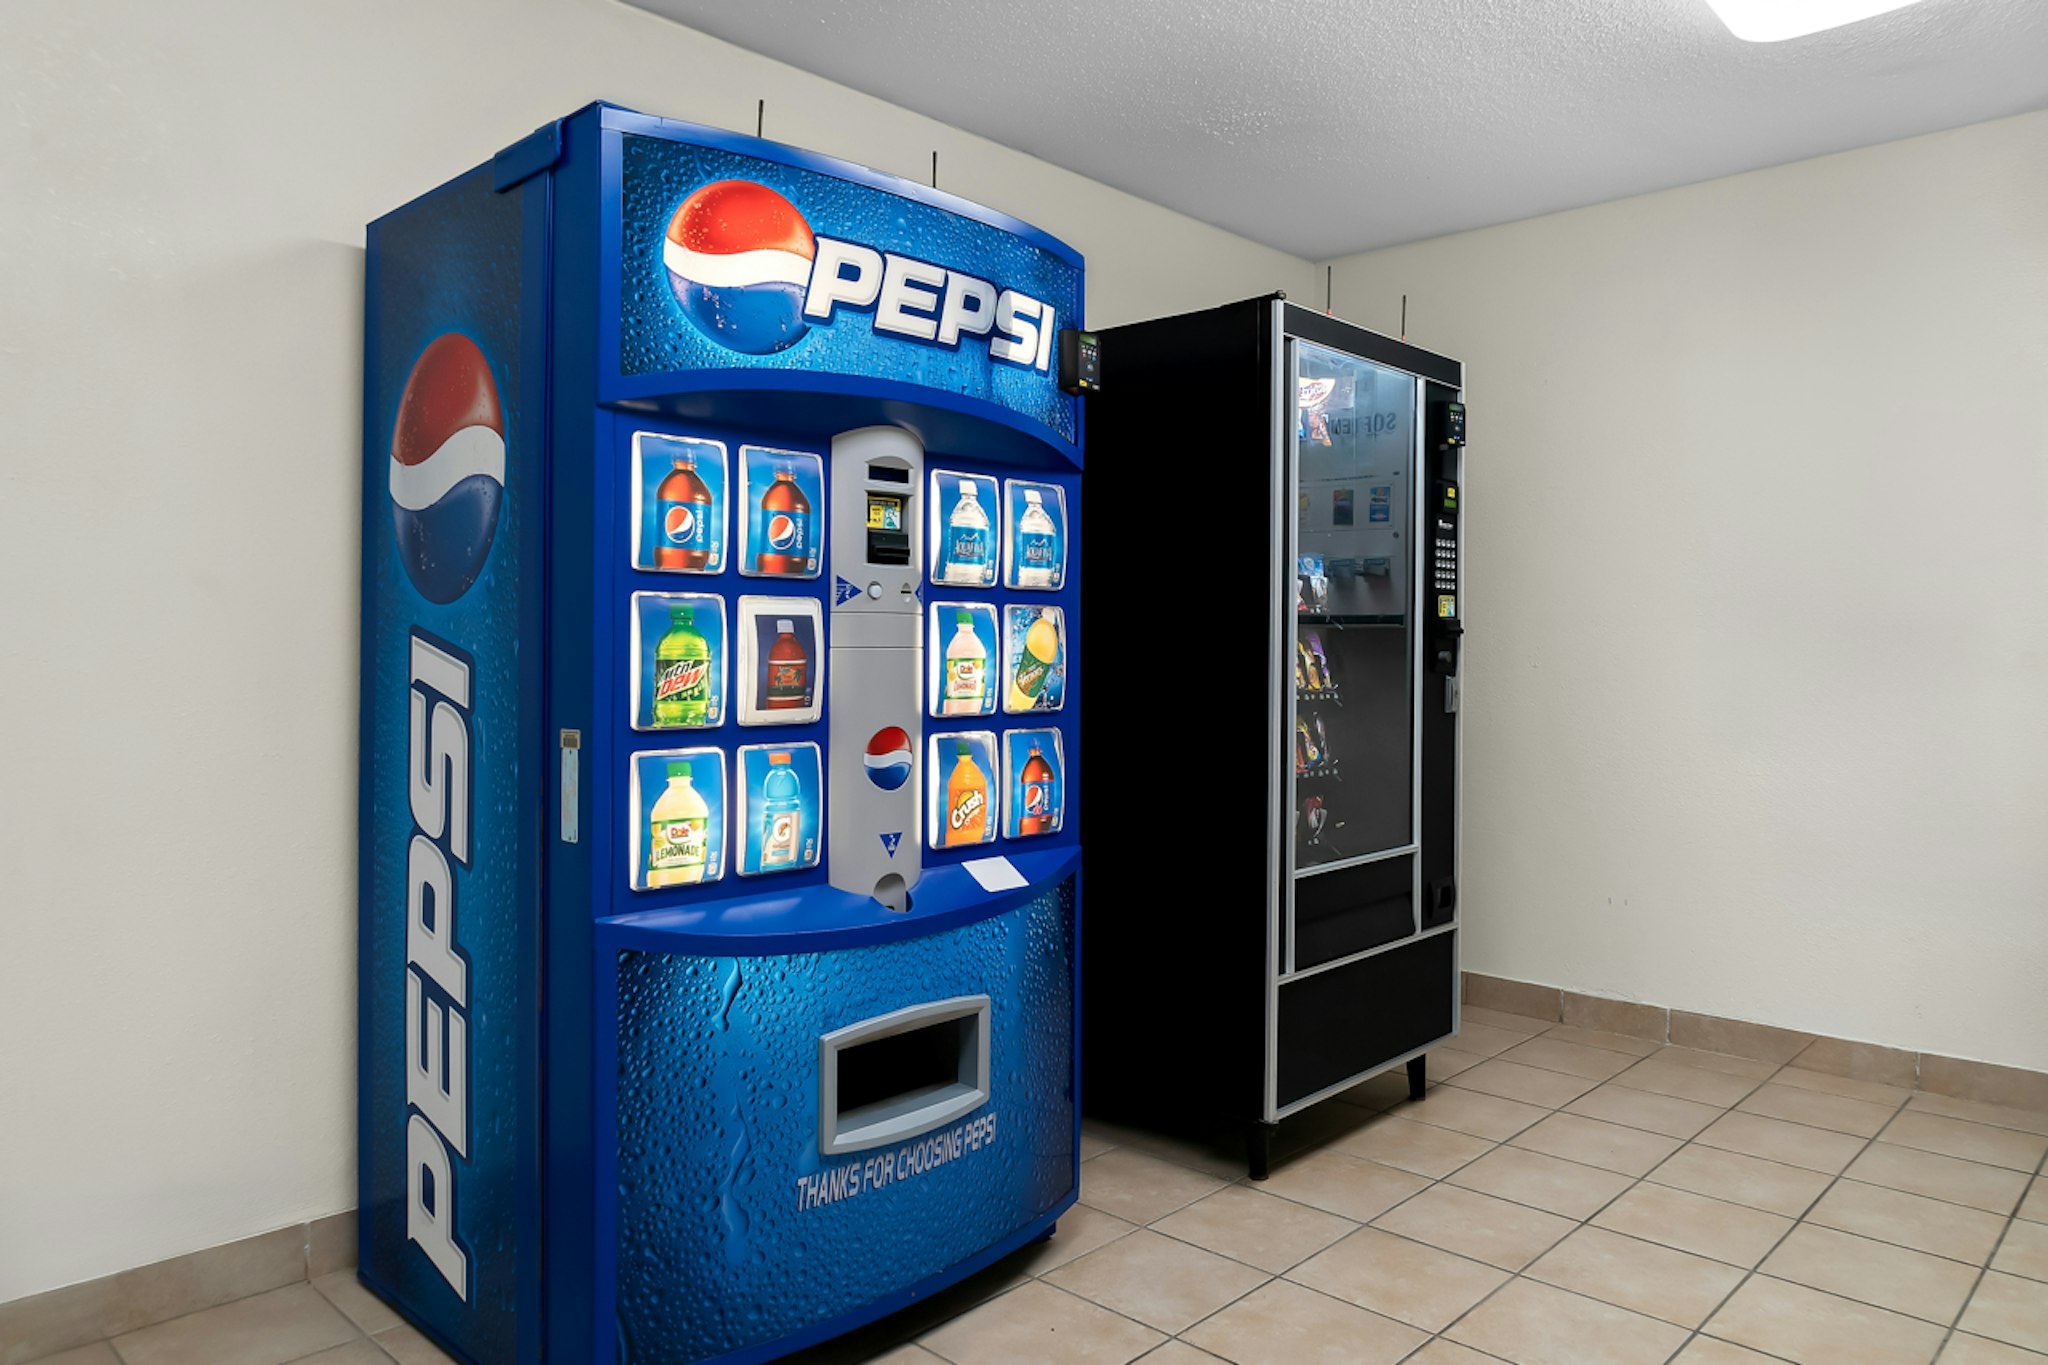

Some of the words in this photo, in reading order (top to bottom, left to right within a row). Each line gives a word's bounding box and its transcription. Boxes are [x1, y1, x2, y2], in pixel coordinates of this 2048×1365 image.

[804, 236, 1057, 373] PEPSI
[671, 827, 689, 837] Dole
[951, 789, 984, 829] Crush
[655, 844, 700, 861] LEMONADE
[406, 634, 469, 1302] PEPSI
[797, 1162, 861, 1212] THANKS
[862, 1151, 895, 1193] FOR
[896, 1126, 963, 1181] CHOOSING
[963, 1112, 998, 1154] PEPSI
